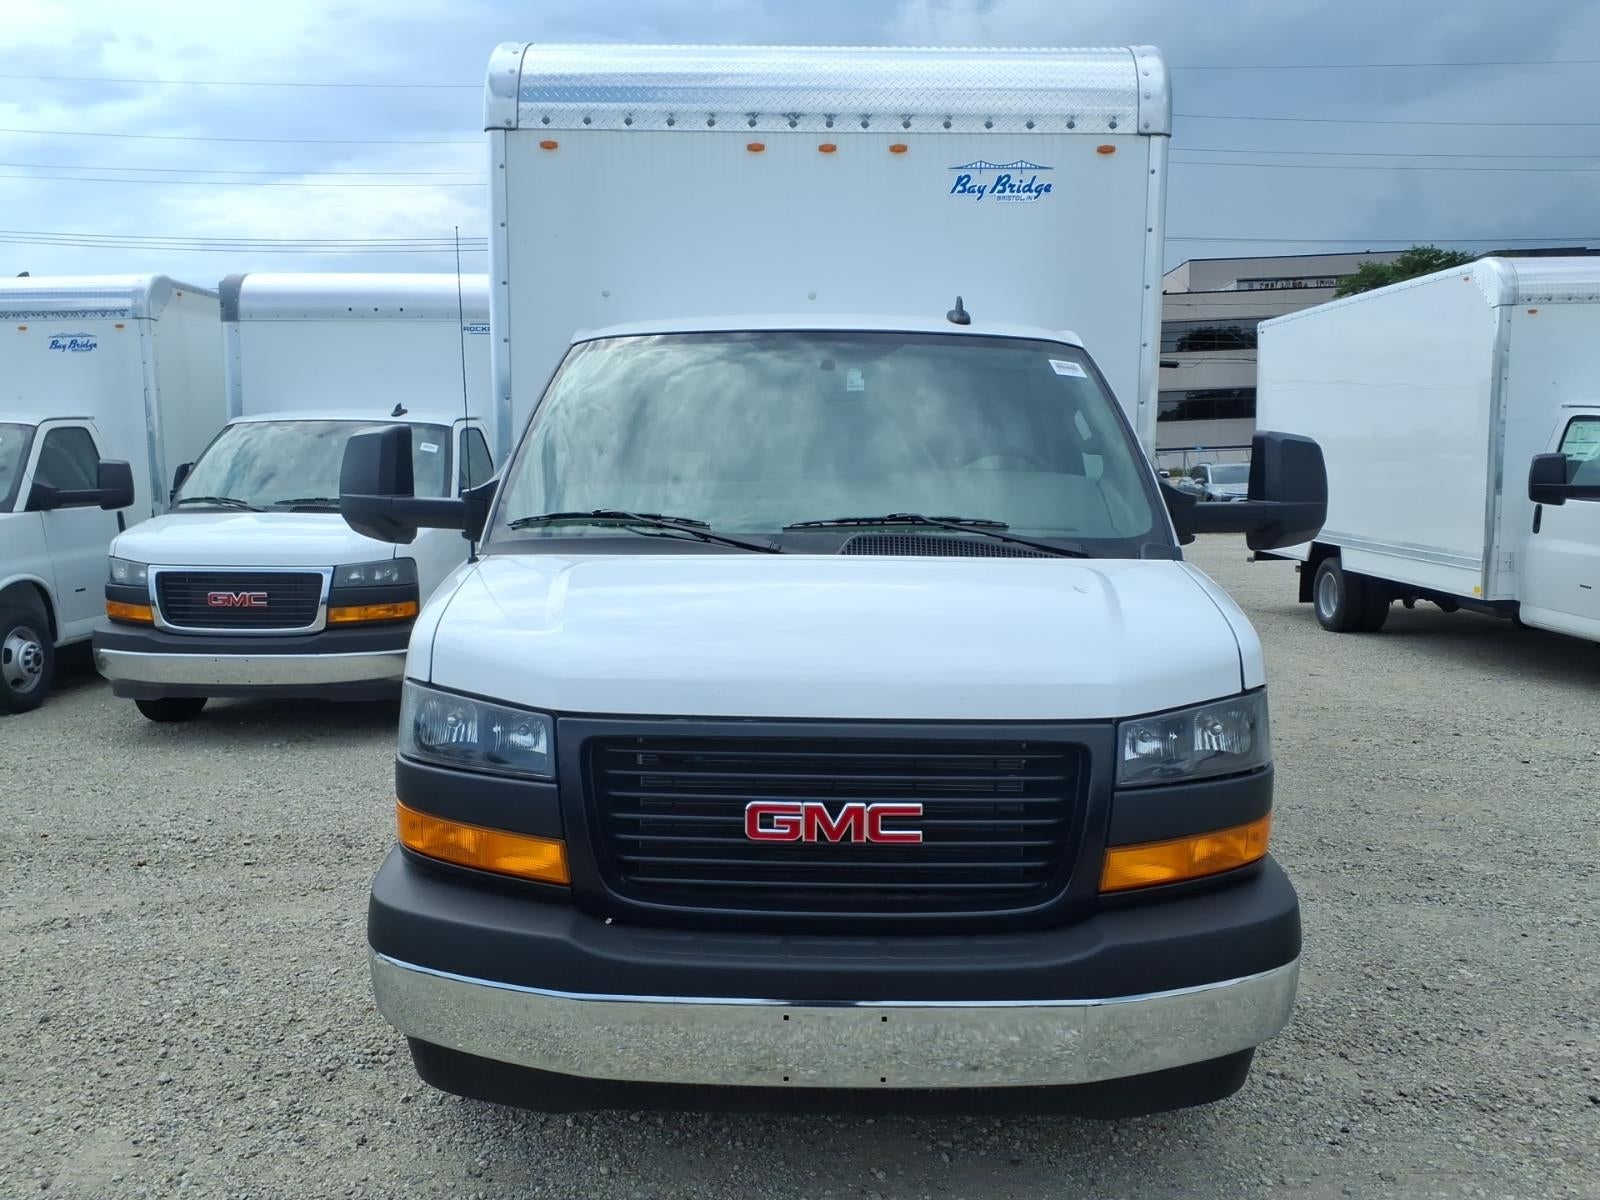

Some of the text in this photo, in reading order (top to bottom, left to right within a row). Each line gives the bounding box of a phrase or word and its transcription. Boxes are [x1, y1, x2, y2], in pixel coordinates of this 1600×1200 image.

[950, 173, 1053, 201] Bay Bridge
[49, 339, 98, 352] Bay Bridge
[207, 591, 268, 607] GMC
[744, 801, 923, 843] GMC
